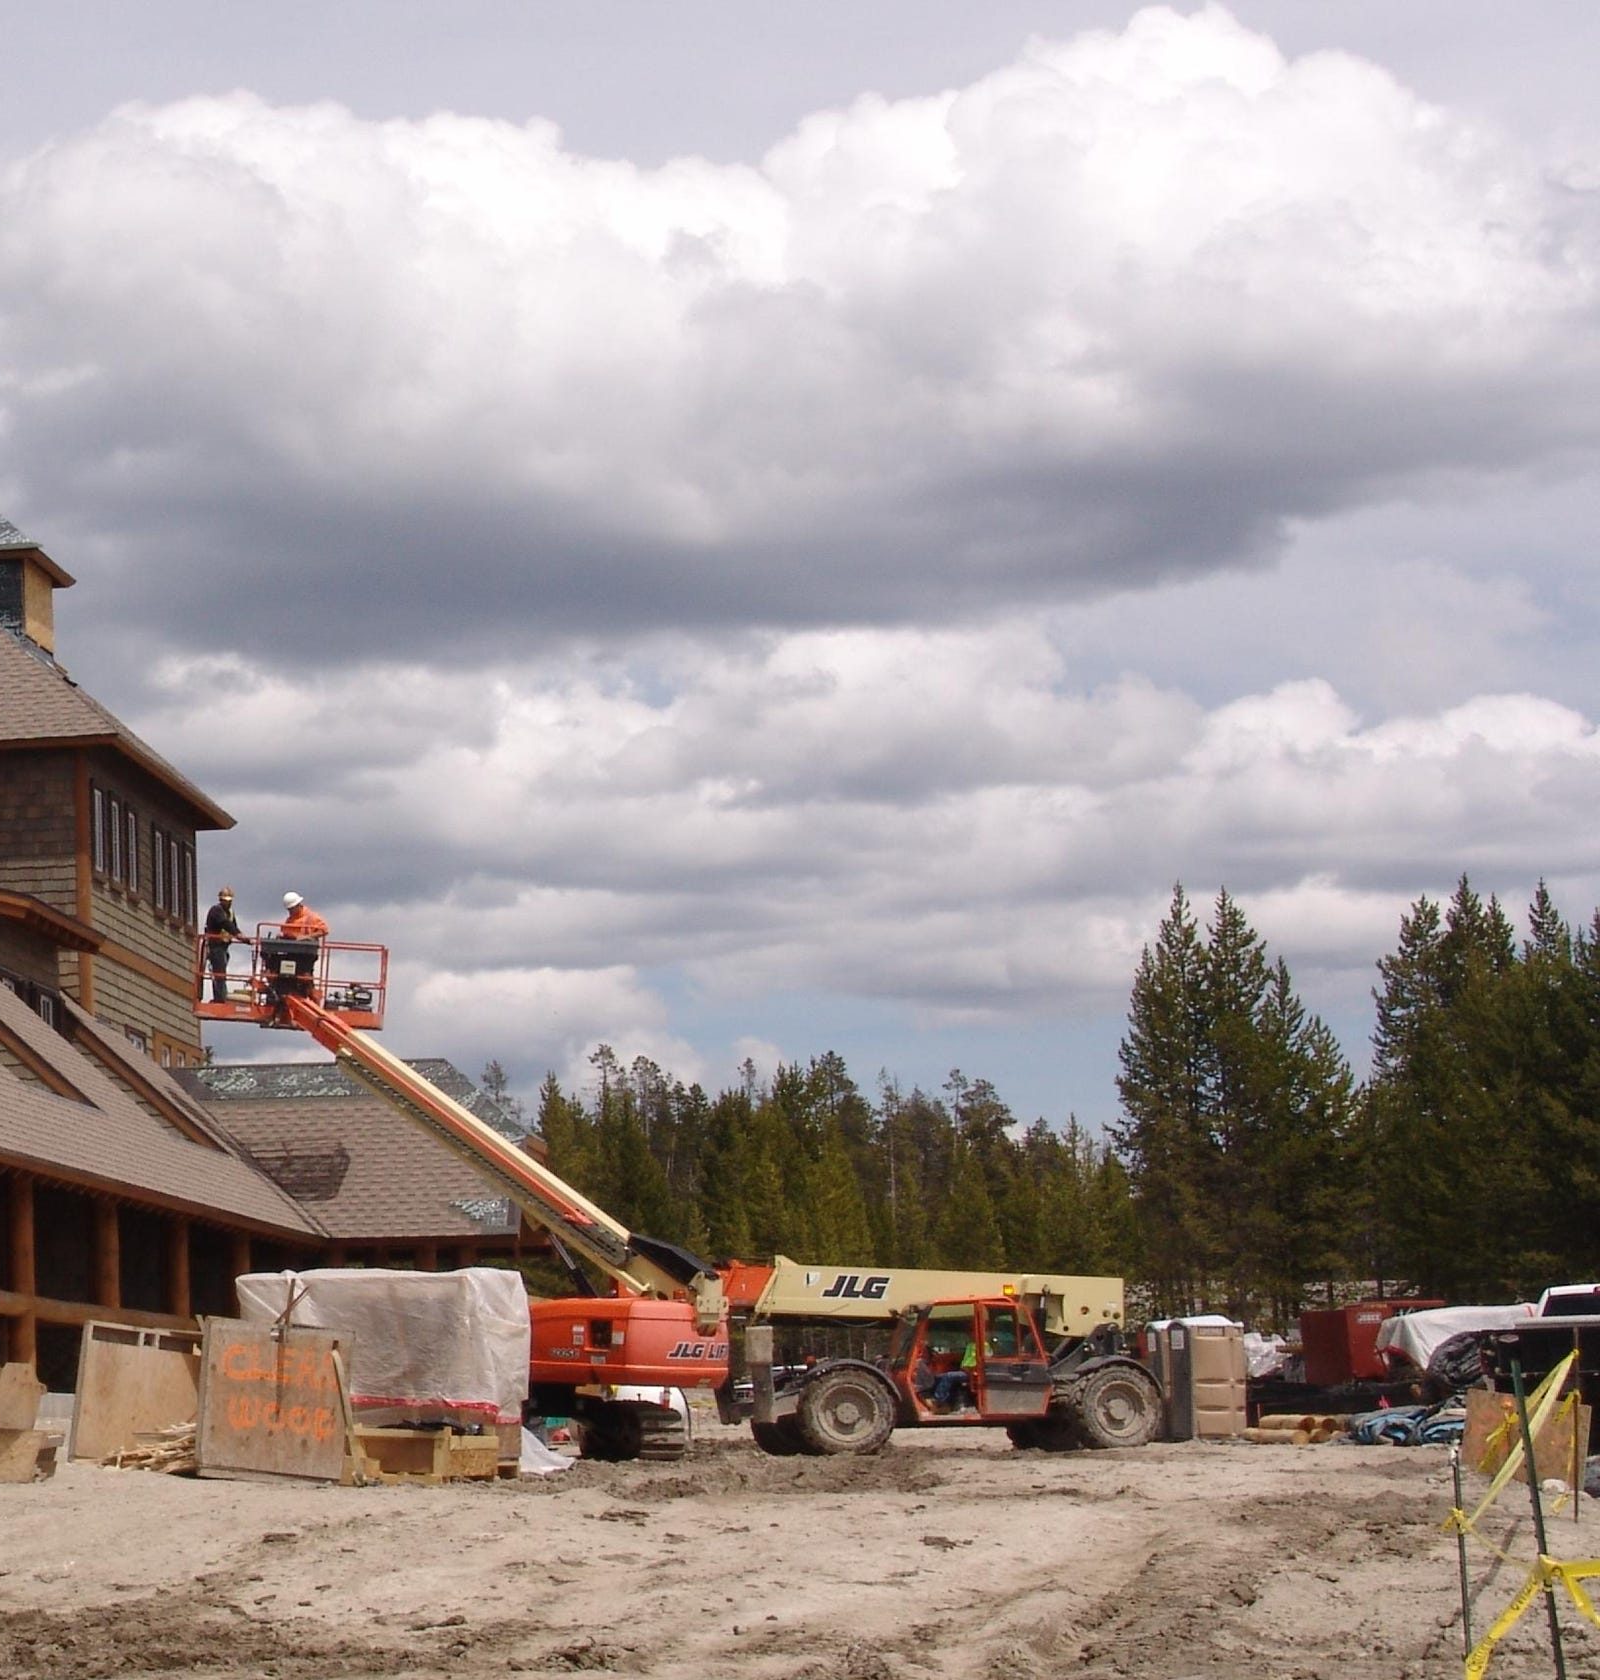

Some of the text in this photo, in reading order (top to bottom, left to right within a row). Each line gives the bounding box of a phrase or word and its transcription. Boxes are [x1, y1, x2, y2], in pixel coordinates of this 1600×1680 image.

[822, 1275, 890, 1299] JLG
[667, 1342, 729, 1359] JLG LIF
[226, 1394, 336, 1442] WOOD
